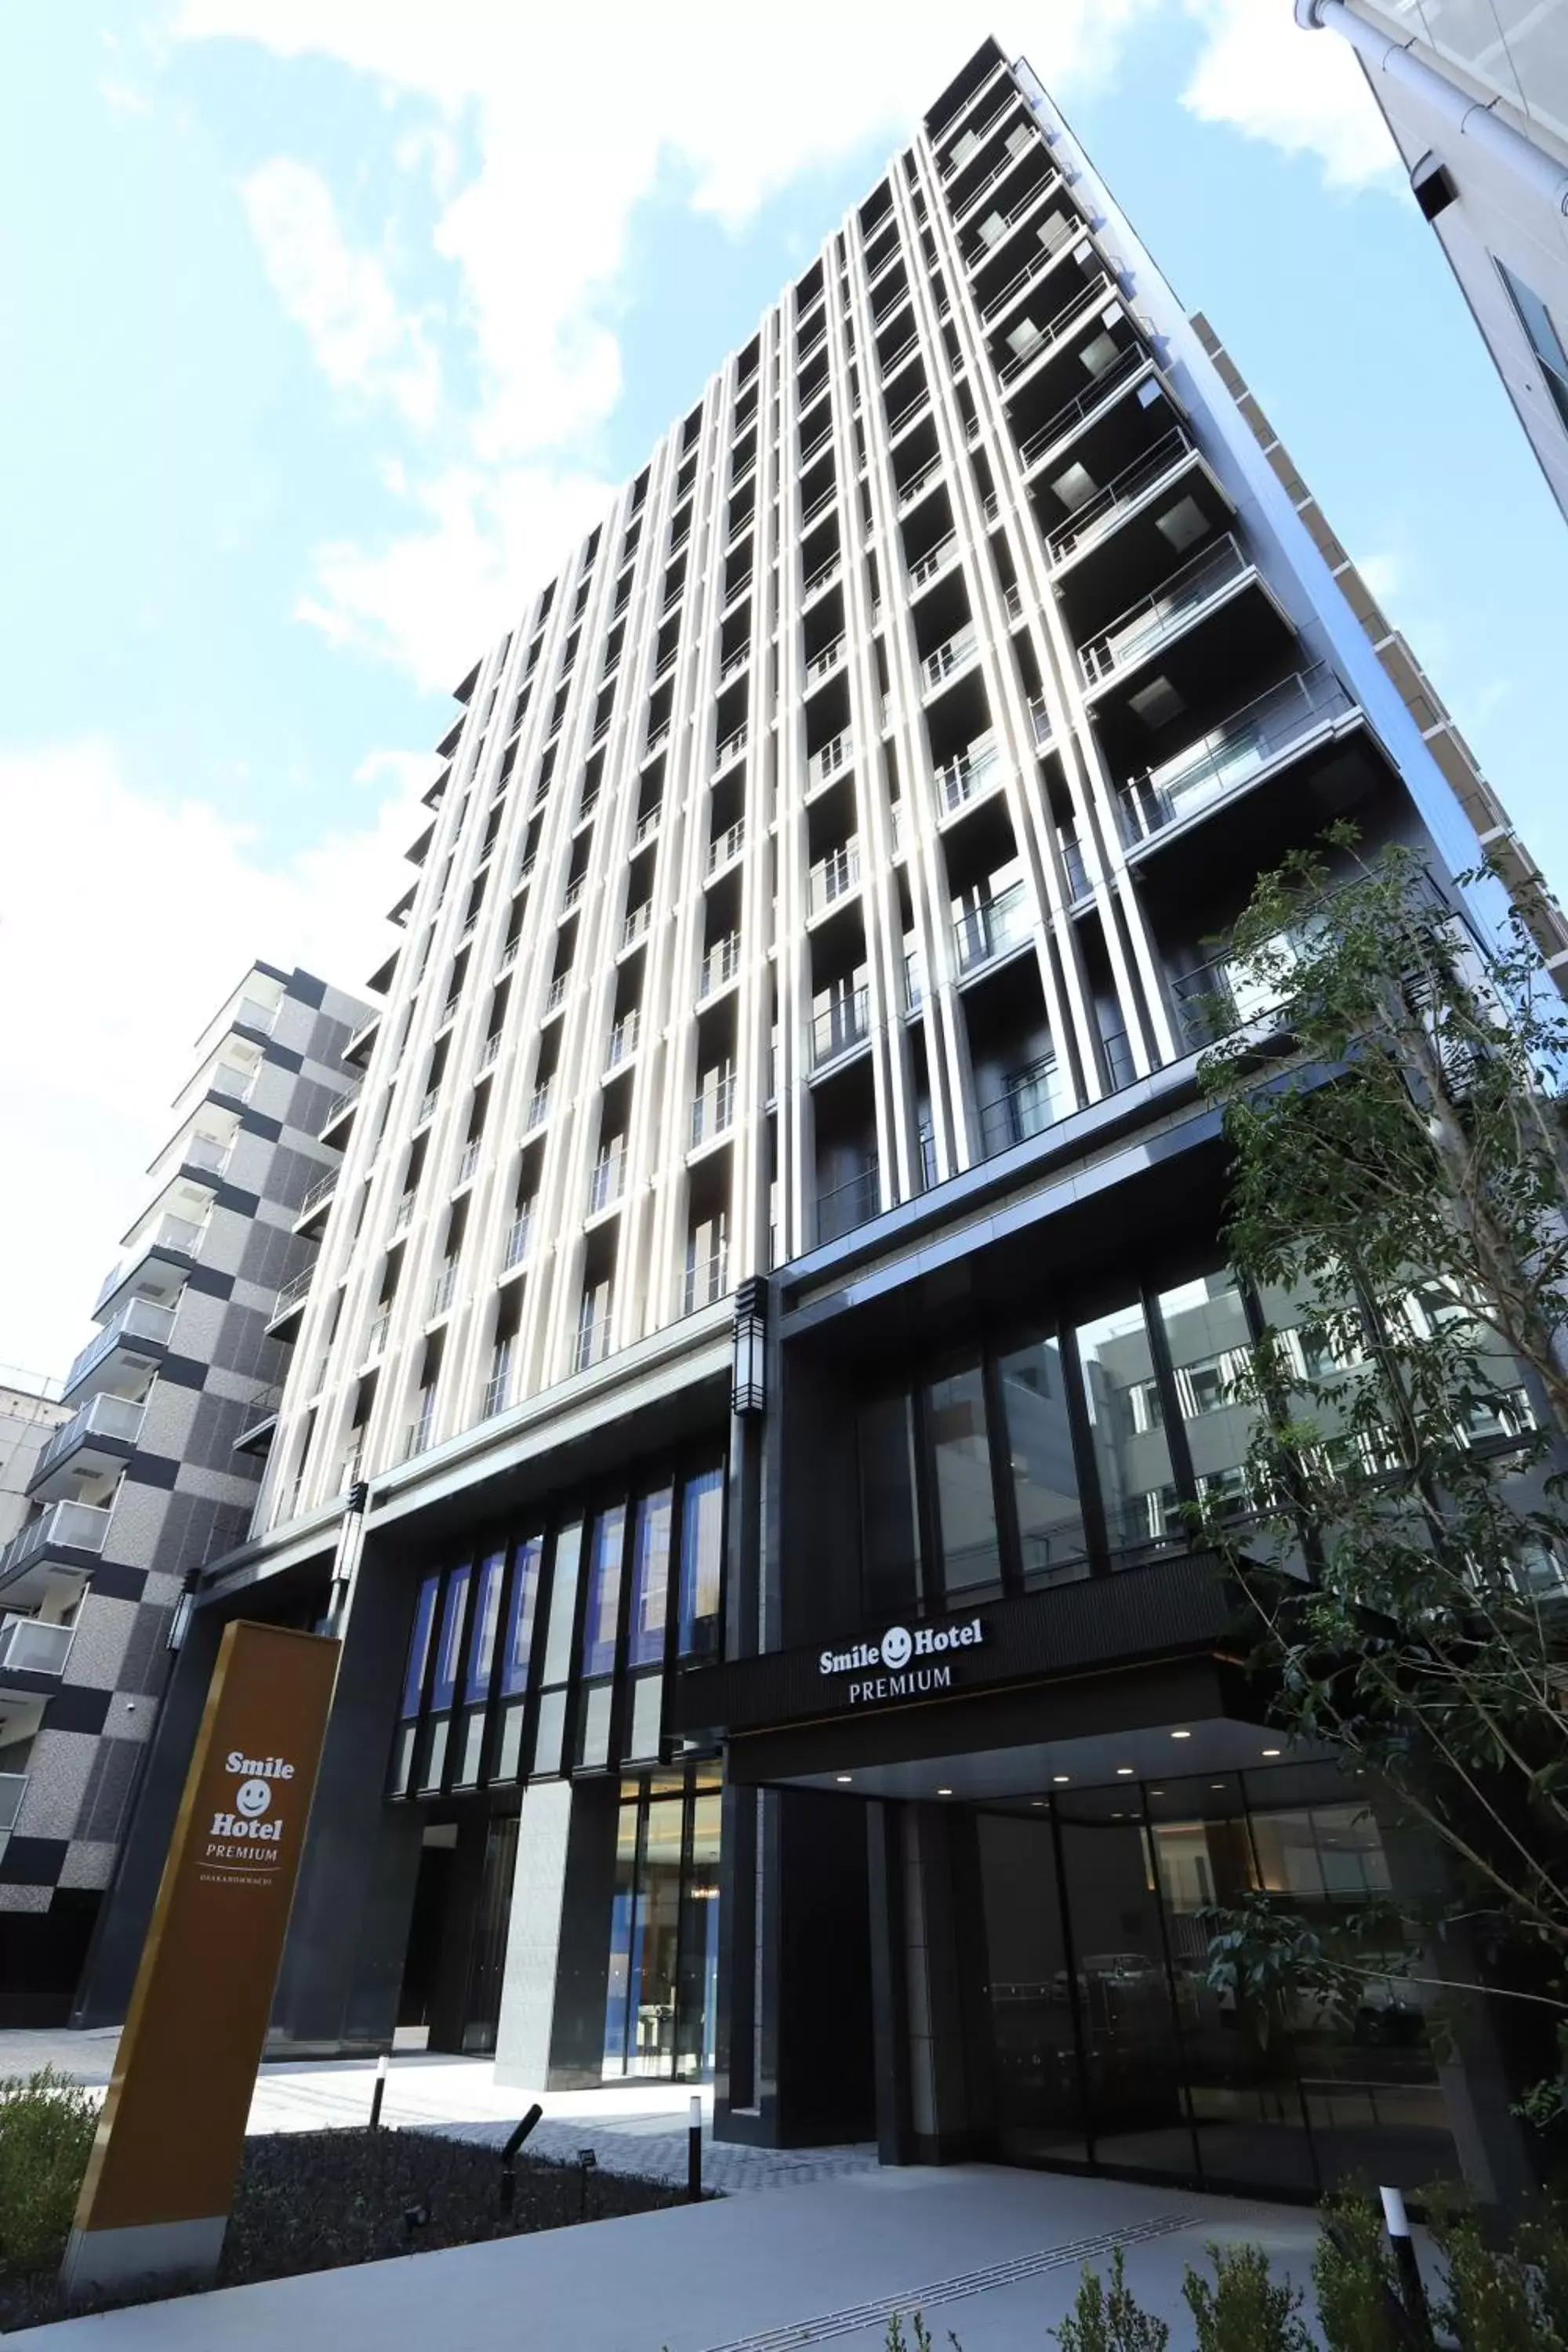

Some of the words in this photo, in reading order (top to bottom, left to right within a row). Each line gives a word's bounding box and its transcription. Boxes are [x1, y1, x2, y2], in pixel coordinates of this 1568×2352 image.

[819, 1644, 880, 1675] Smile
[913, 1618, 983, 1655] Hotel
[849, 1665, 951, 1704] PREMIUM
[225, 1751, 295, 1779] Smile
[210, 1812, 282, 1841] Hotel
[205, 1844, 278, 1861] PREMIUM
